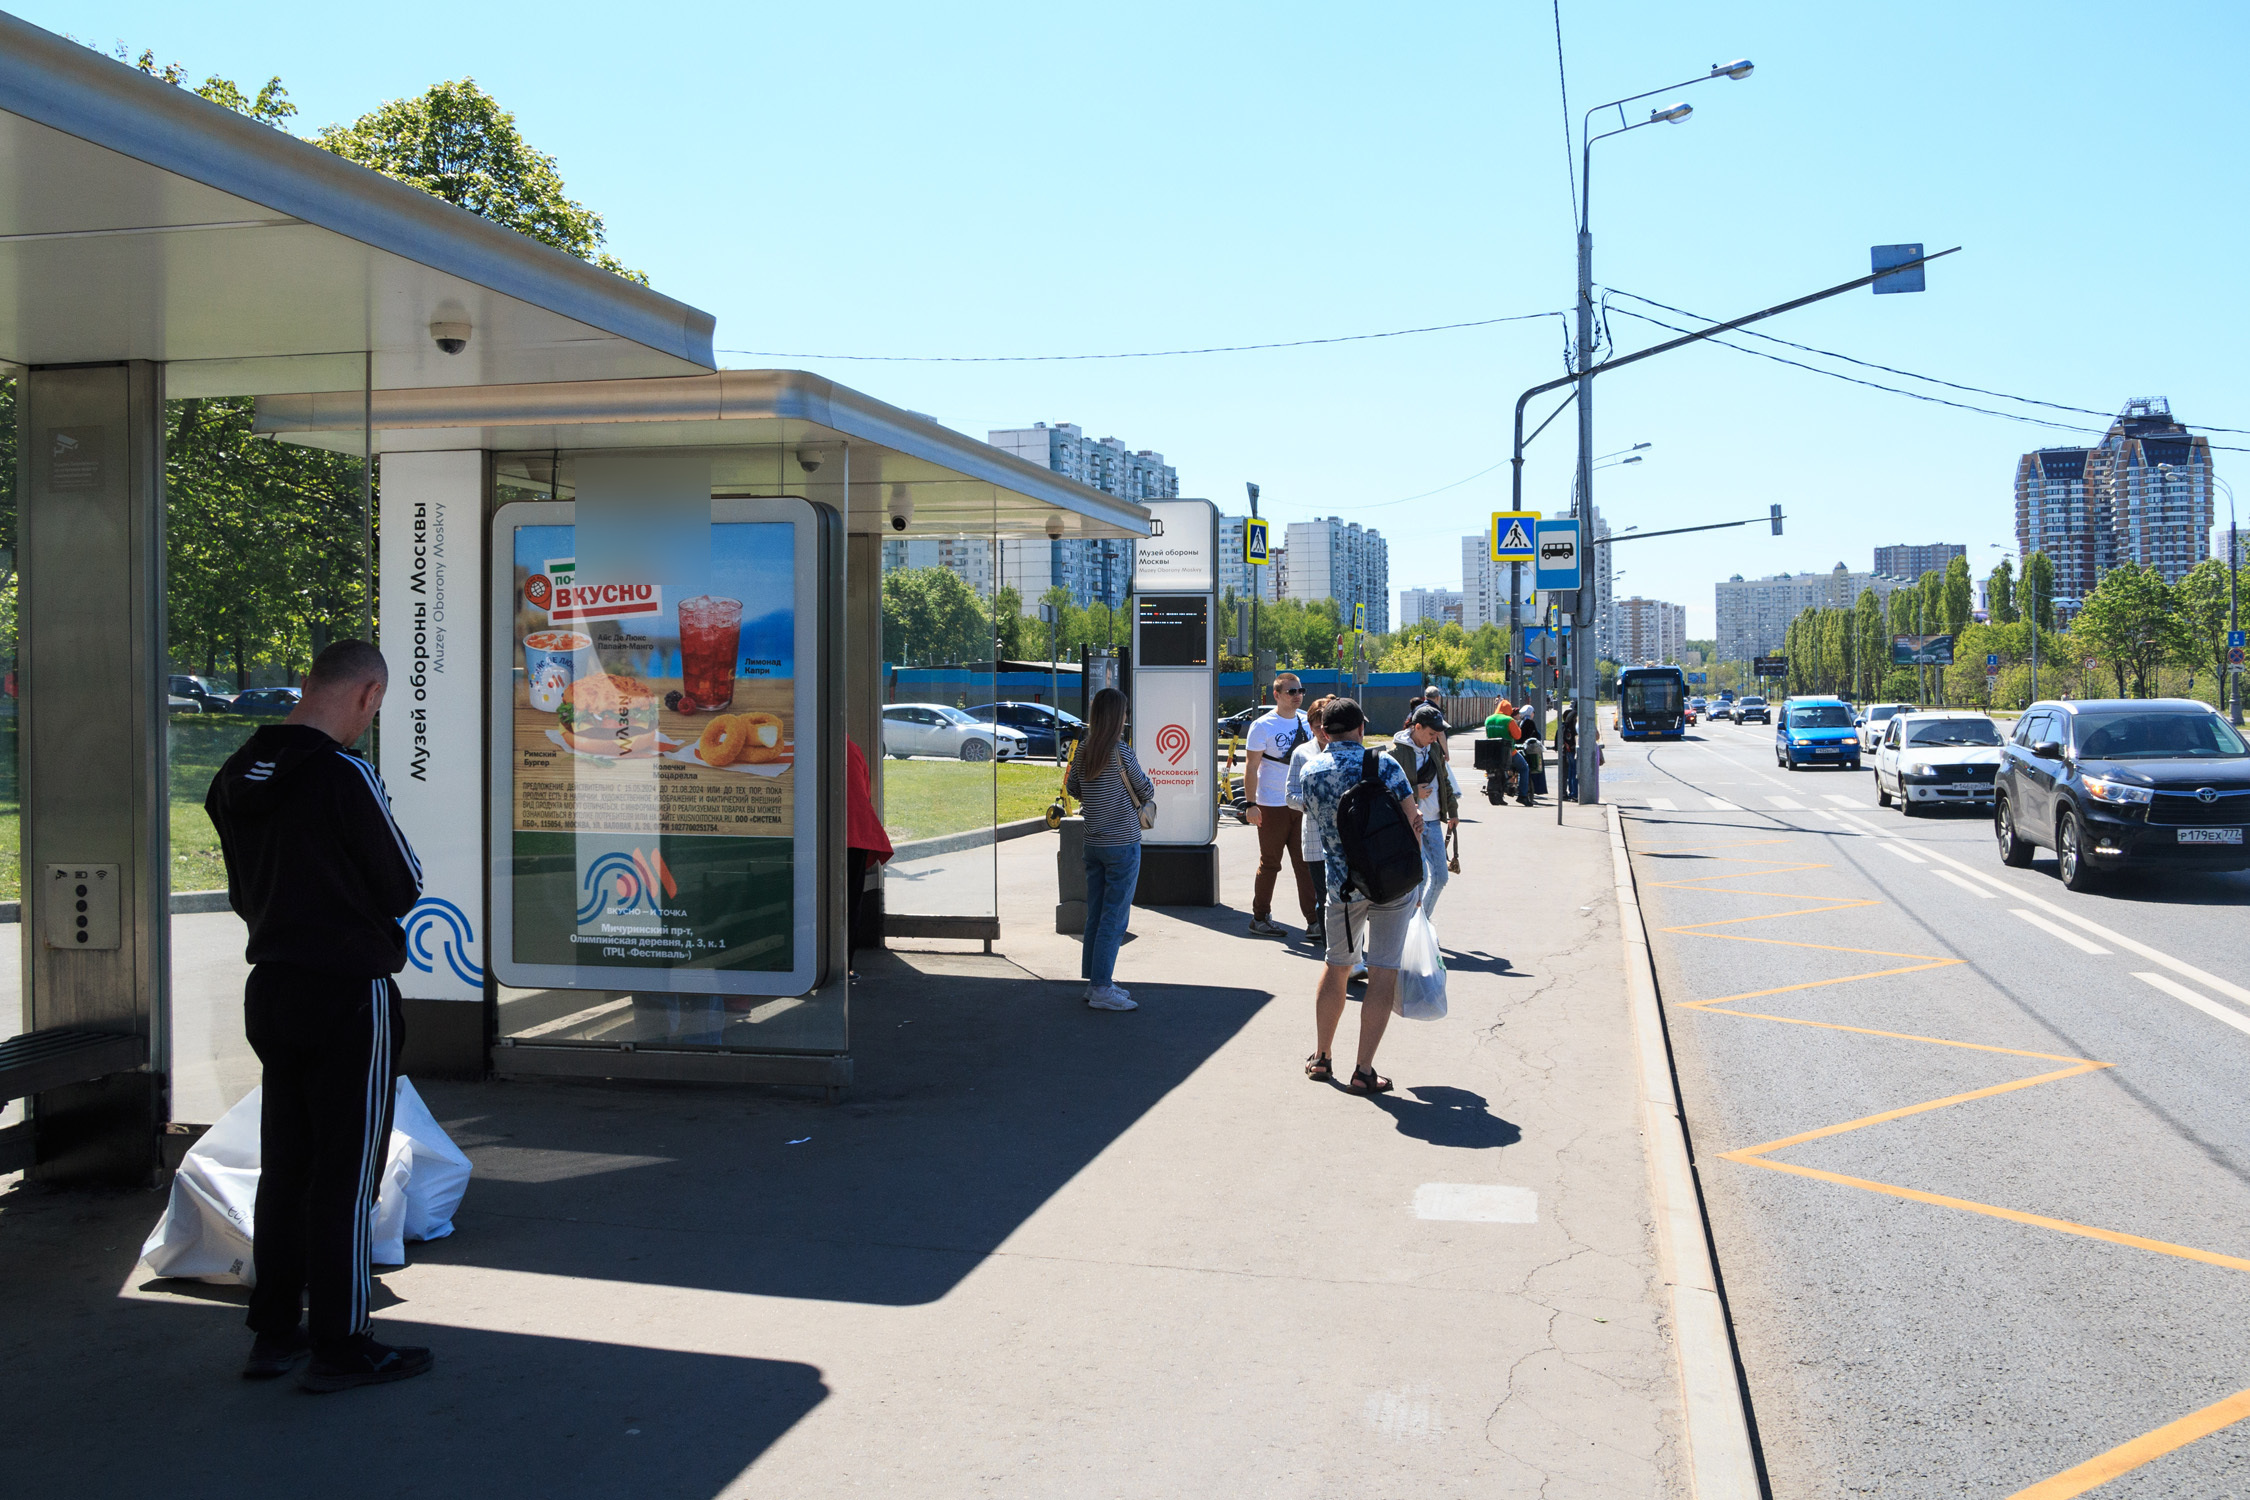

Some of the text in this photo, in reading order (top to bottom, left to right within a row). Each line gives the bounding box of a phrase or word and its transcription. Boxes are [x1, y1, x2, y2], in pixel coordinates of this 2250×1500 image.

[433, 503, 446, 673] Muzey Oborony Moskvy
[556, 585, 652, 608] ВКУСНО
[410, 503, 430, 781] Музей обороны Москвы
[745, 658, 781, 666] Лимонад
[524, 759, 549, 767] Бургер
[653, 763, 685, 771] Колечки
[653, 772, 698, 780] Моцарелла
[1152, 777, 1194, 786] Транспорт
[523, 782, 564, 790] ПРЕДЛОЖЕНИЕ
[723, 786, 732, 794] ДО
[736, 786, 745, 794] ТЕХ
[549, 792, 560, 800] ЕСТЬ
[706, 795, 748, 803] ФАКТИЧЕСКИЙ
[751, 796, 782, 804] ВНЕШНИЙ
[757, 806, 782, 814] МОЖЕТЕ
[607, 908, 641, 916] ВКУСНО
[660, 909, 688, 917] ТОЧКА
[602, 923, 693, 937] Мичуринский пр-т,
[570, 934, 637, 945] Олимпийская
[639, 938, 683, 948] деревня,
[685, 940, 694, 948] д.
[697, 939, 706, 949] 3,
[719, 939, 725, 948] 1
[603, 948, 625, 957] (ТРЦ
